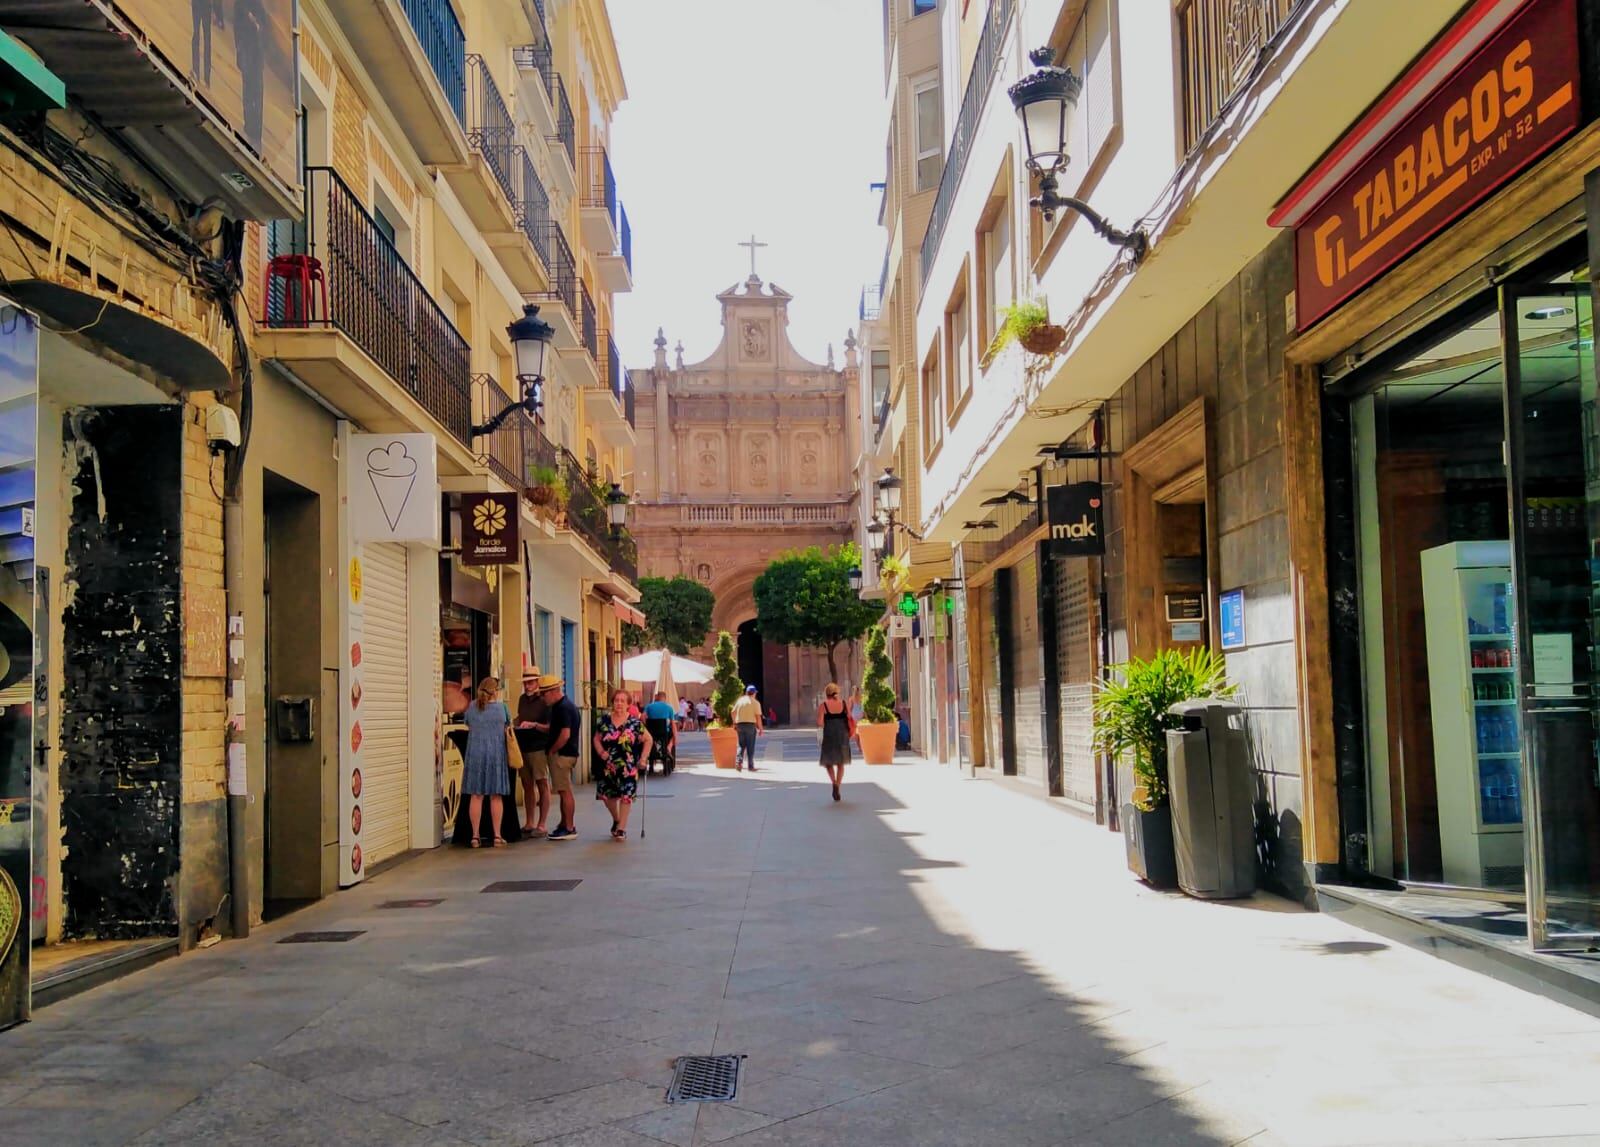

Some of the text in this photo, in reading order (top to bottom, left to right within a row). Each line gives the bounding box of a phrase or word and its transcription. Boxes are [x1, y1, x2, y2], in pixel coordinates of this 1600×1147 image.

[1353, 39, 1534, 241] TABACOS
[1470, 150, 1495, 175] EXP.
[1516, 113, 1534, 140] 52
[1052, 514, 1097, 539] mak
[473, 545, 507, 554] Jamaica
